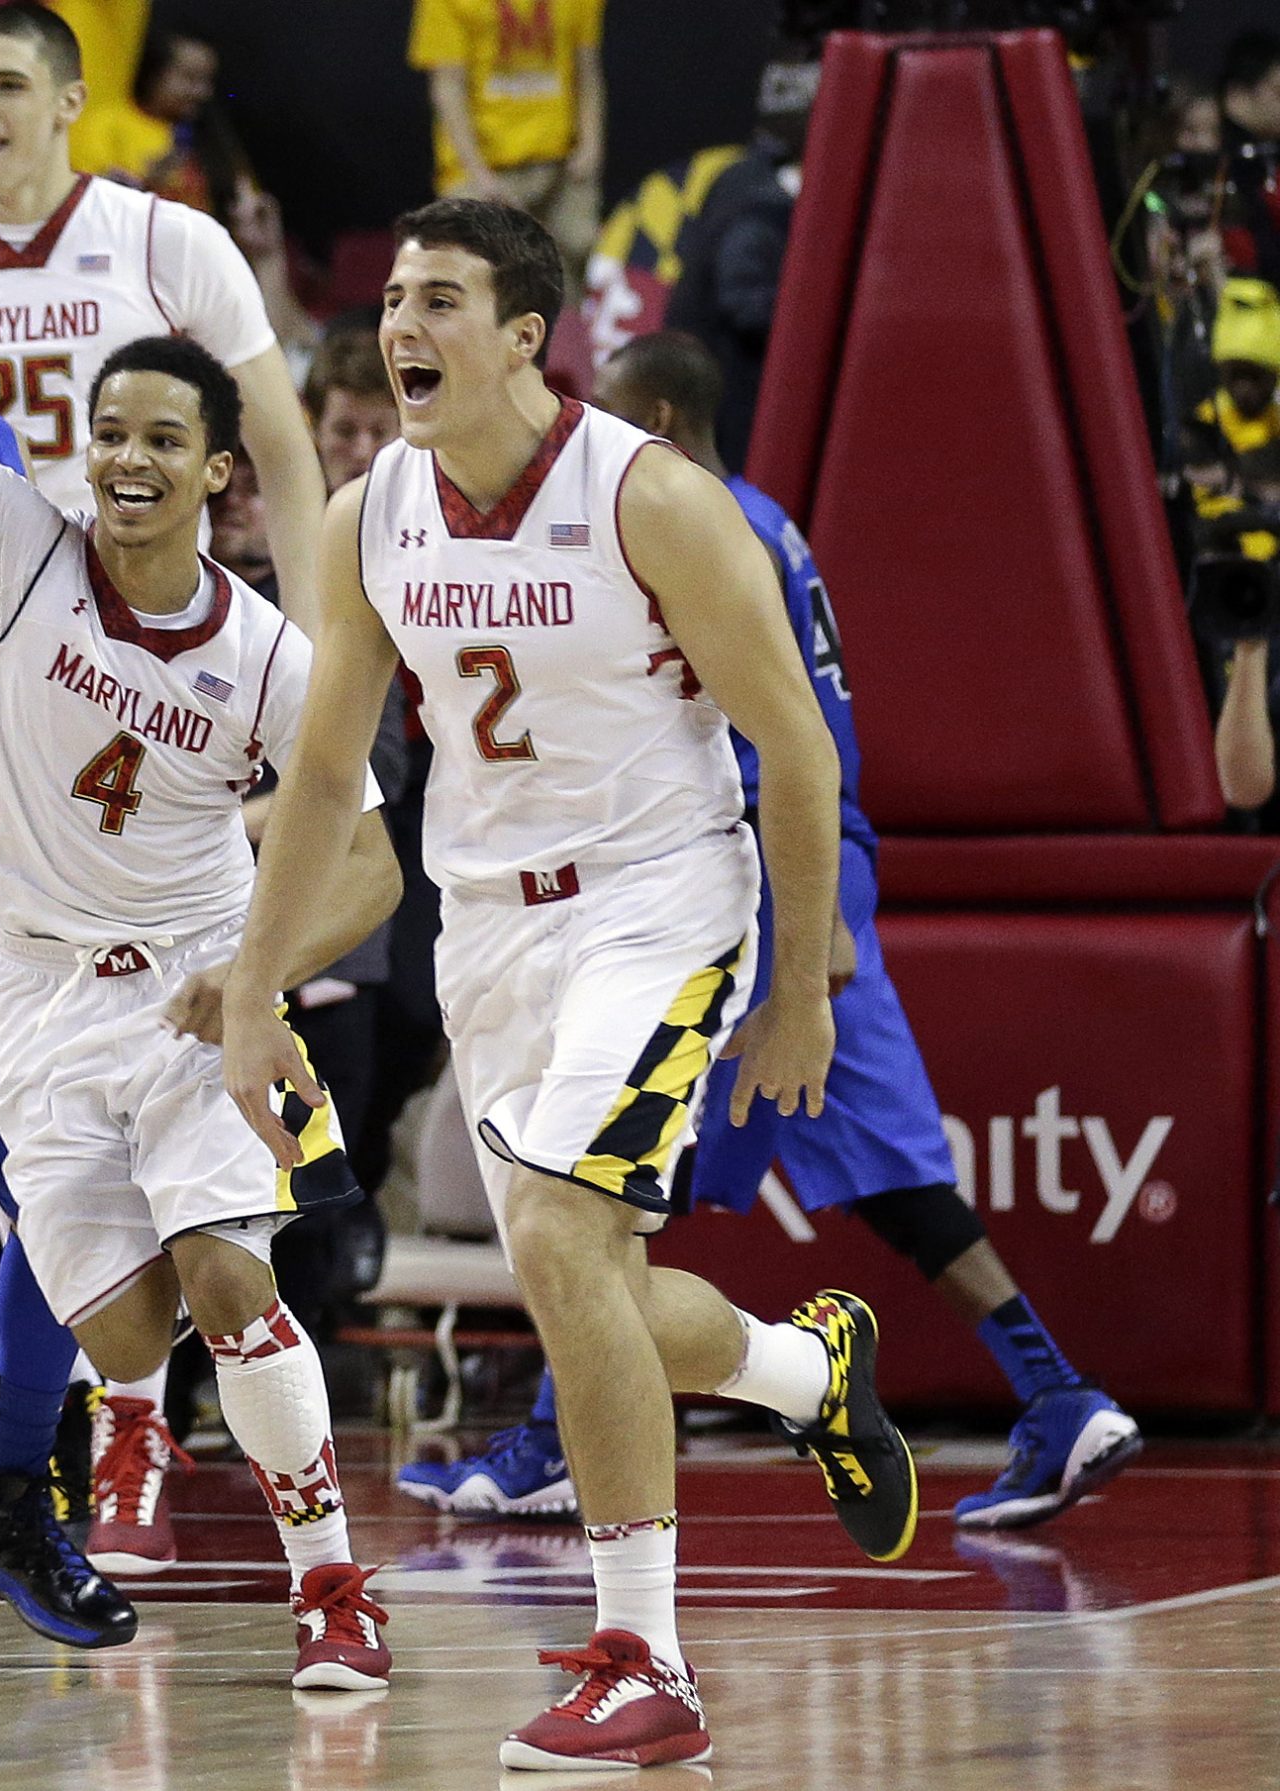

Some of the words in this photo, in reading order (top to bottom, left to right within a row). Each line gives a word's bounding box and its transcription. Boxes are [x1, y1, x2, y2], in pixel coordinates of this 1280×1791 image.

[400, 582, 574, 629] MARYLAND
[45, 642, 213, 754] MARYLAND
[455, 645, 539, 763] 2
[71, 730, 148, 836] 4
[108, 950, 138, 972] M
